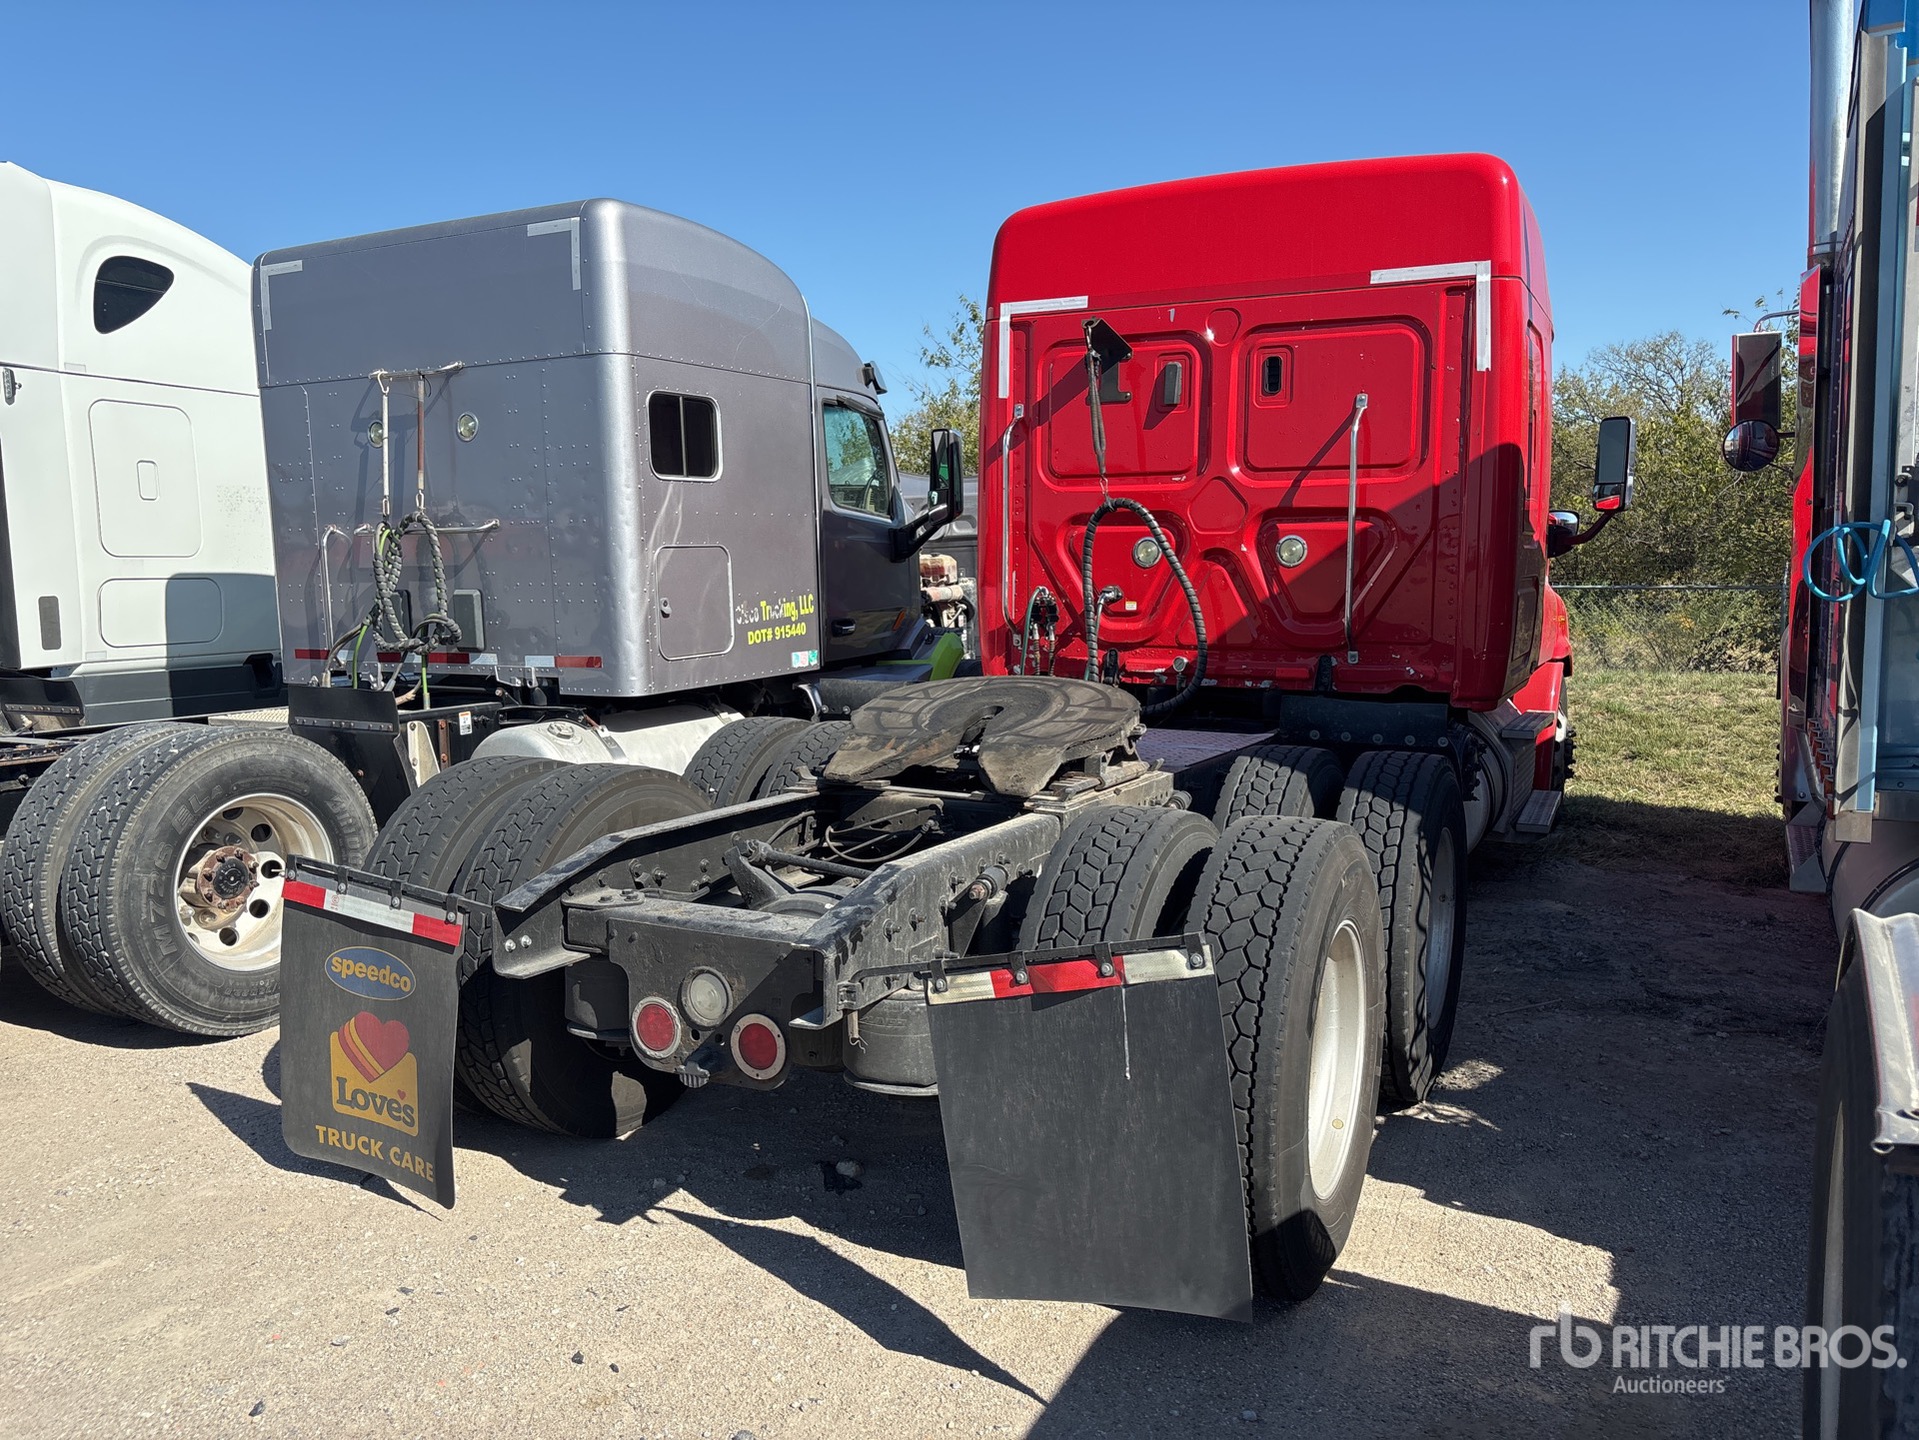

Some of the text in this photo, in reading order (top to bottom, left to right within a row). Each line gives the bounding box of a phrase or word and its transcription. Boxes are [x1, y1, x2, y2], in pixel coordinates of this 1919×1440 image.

[799, 594, 815, 615] LLC
[747, 622, 807, 645] DOT# 915440
[330, 956, 412, 992] speedco
[315, 1124, 434, 1183] TRUCK CARE
